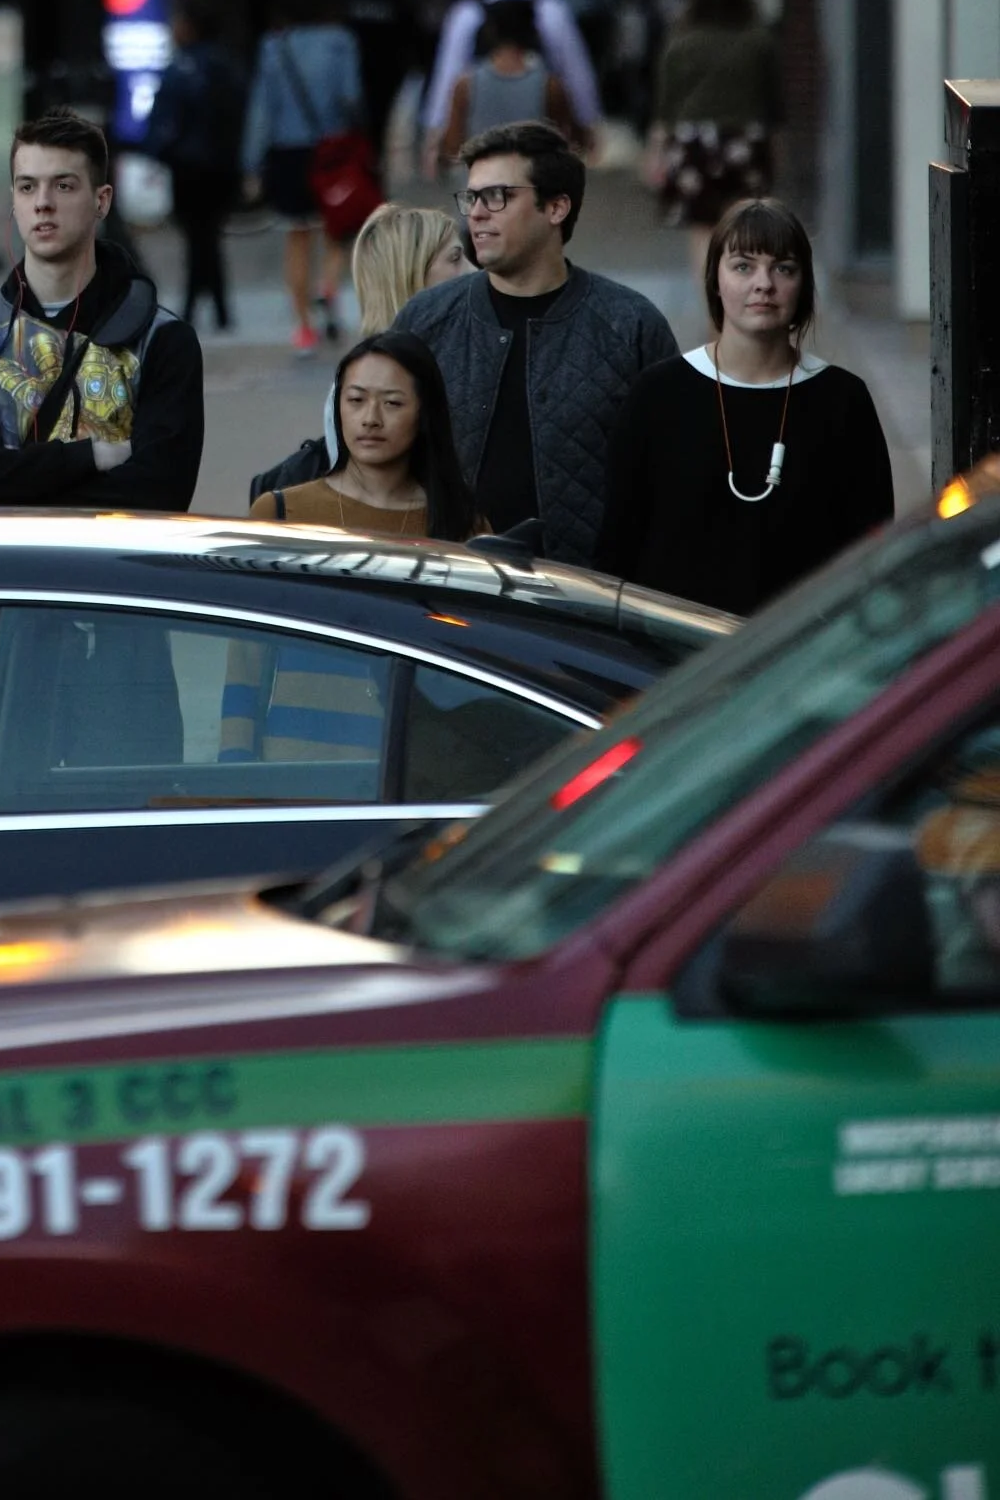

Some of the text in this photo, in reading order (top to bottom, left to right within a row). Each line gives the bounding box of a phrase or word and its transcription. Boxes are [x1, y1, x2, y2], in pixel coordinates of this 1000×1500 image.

[62, 1077, 96, 1130] 3
[117, 1061, 240, 1125] CCC
[767, 1333, 953, 1400] Book
